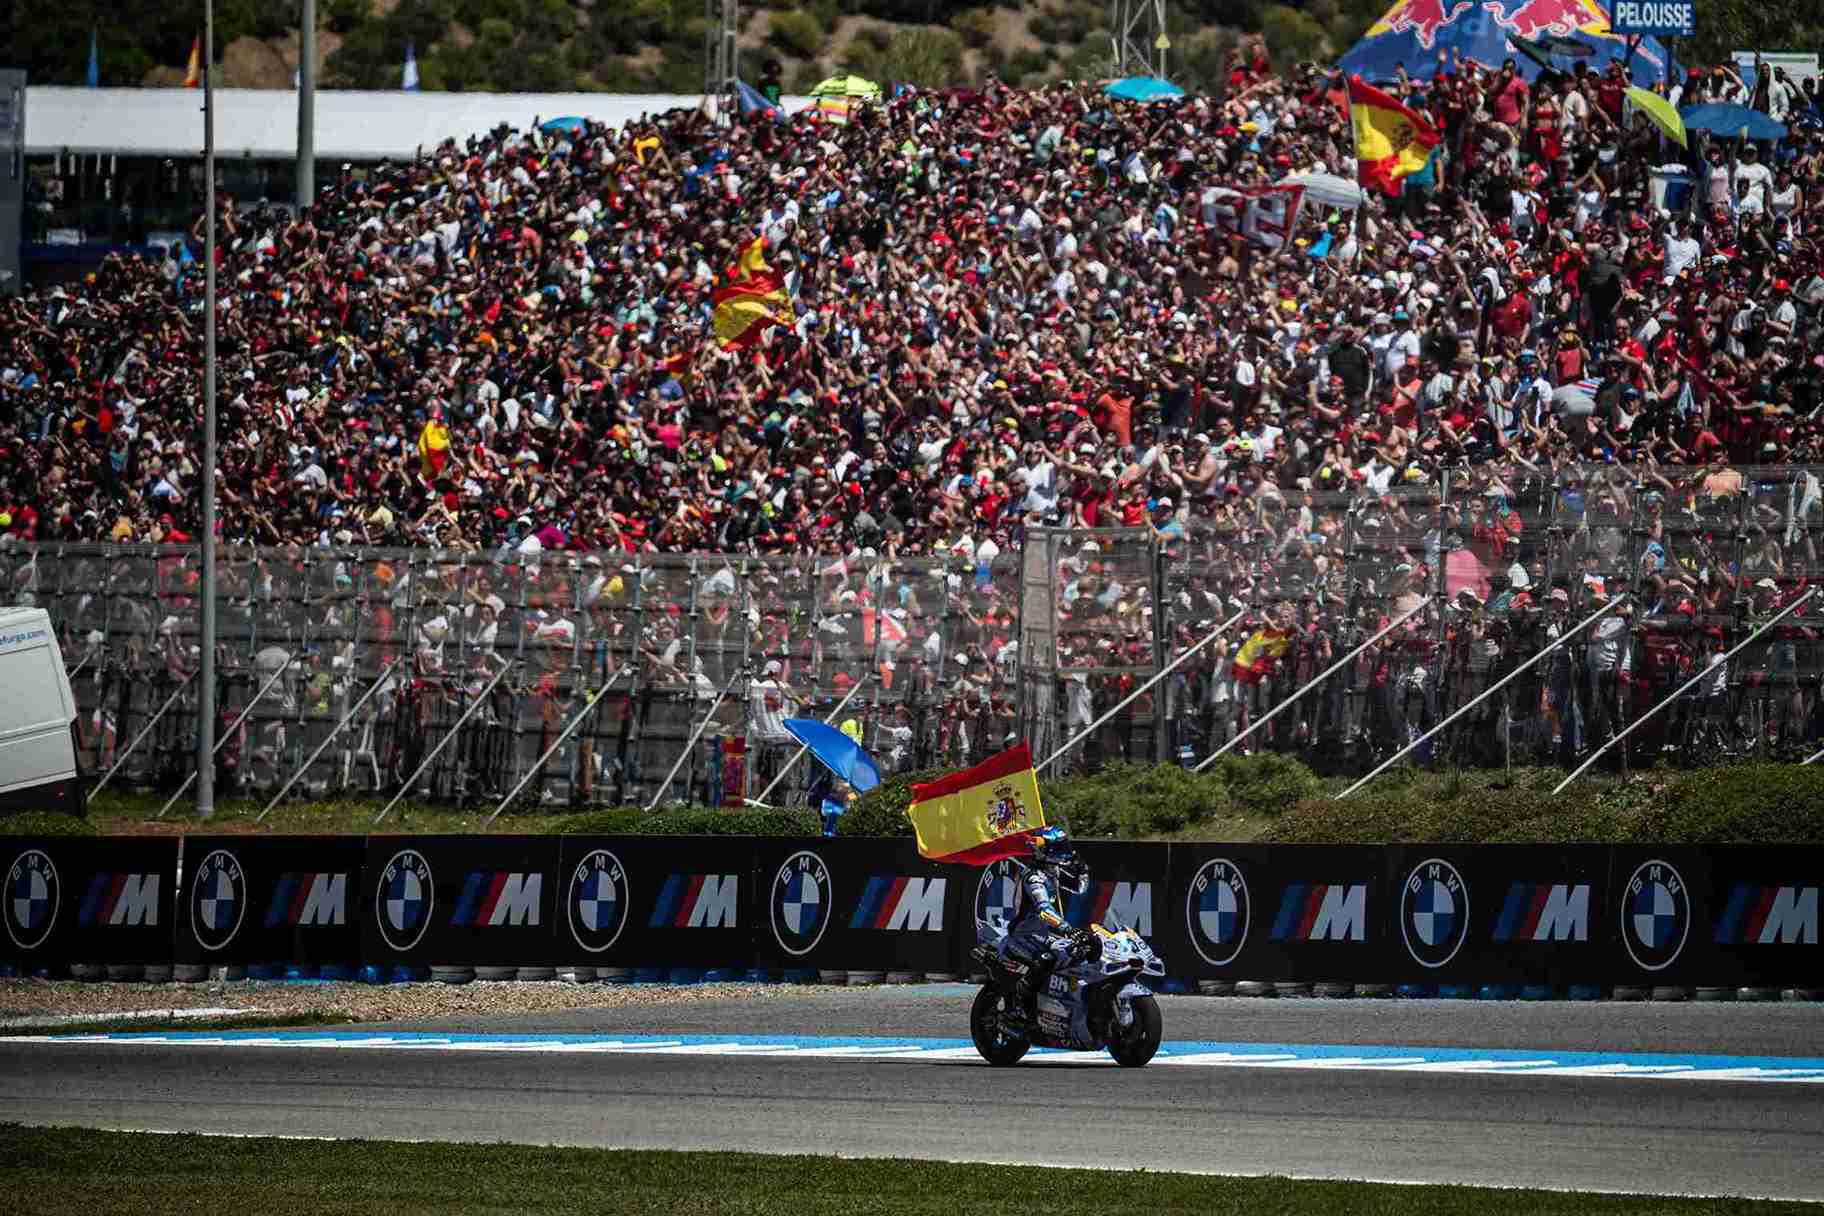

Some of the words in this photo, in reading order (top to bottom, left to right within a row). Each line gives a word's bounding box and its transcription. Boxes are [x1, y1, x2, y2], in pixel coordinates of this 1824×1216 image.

[1616, 1, 1691, 27] PELOUSSE
[12, 855, 53, 881] BMW
[201, 855, 239, 881] BMW
[386, 855, 428, 881] BMW
[578, 855, 622, 881] BMW
[782, 857, 825, 885] BMW
[1196, 864, 1241, 893] BMW
[1408, 864, 1460, 893] BMW
[1632, 866, 1680, 894] BMW
